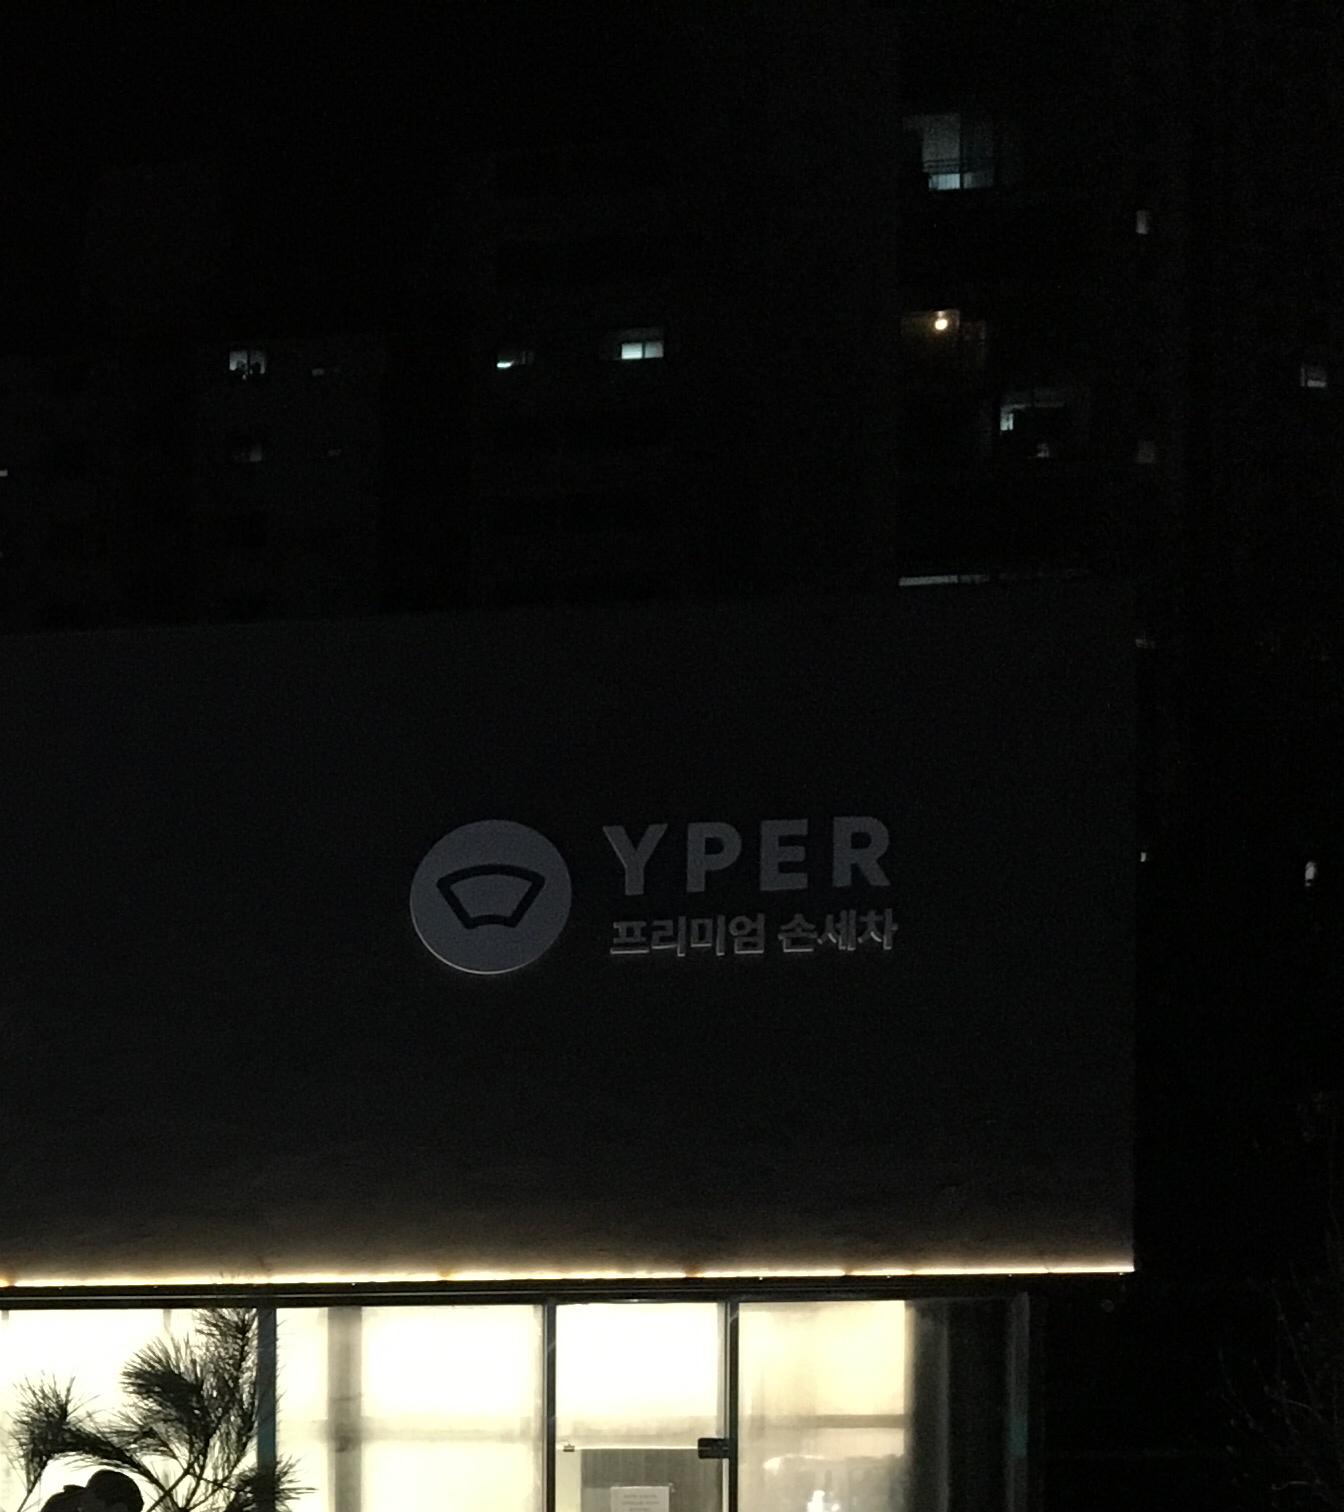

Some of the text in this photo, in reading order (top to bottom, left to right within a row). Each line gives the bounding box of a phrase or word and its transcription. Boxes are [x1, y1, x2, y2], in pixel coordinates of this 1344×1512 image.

[602, 815, 891, 897] YPER
[610, 907, 899, 958] 프리미엄 손세차
